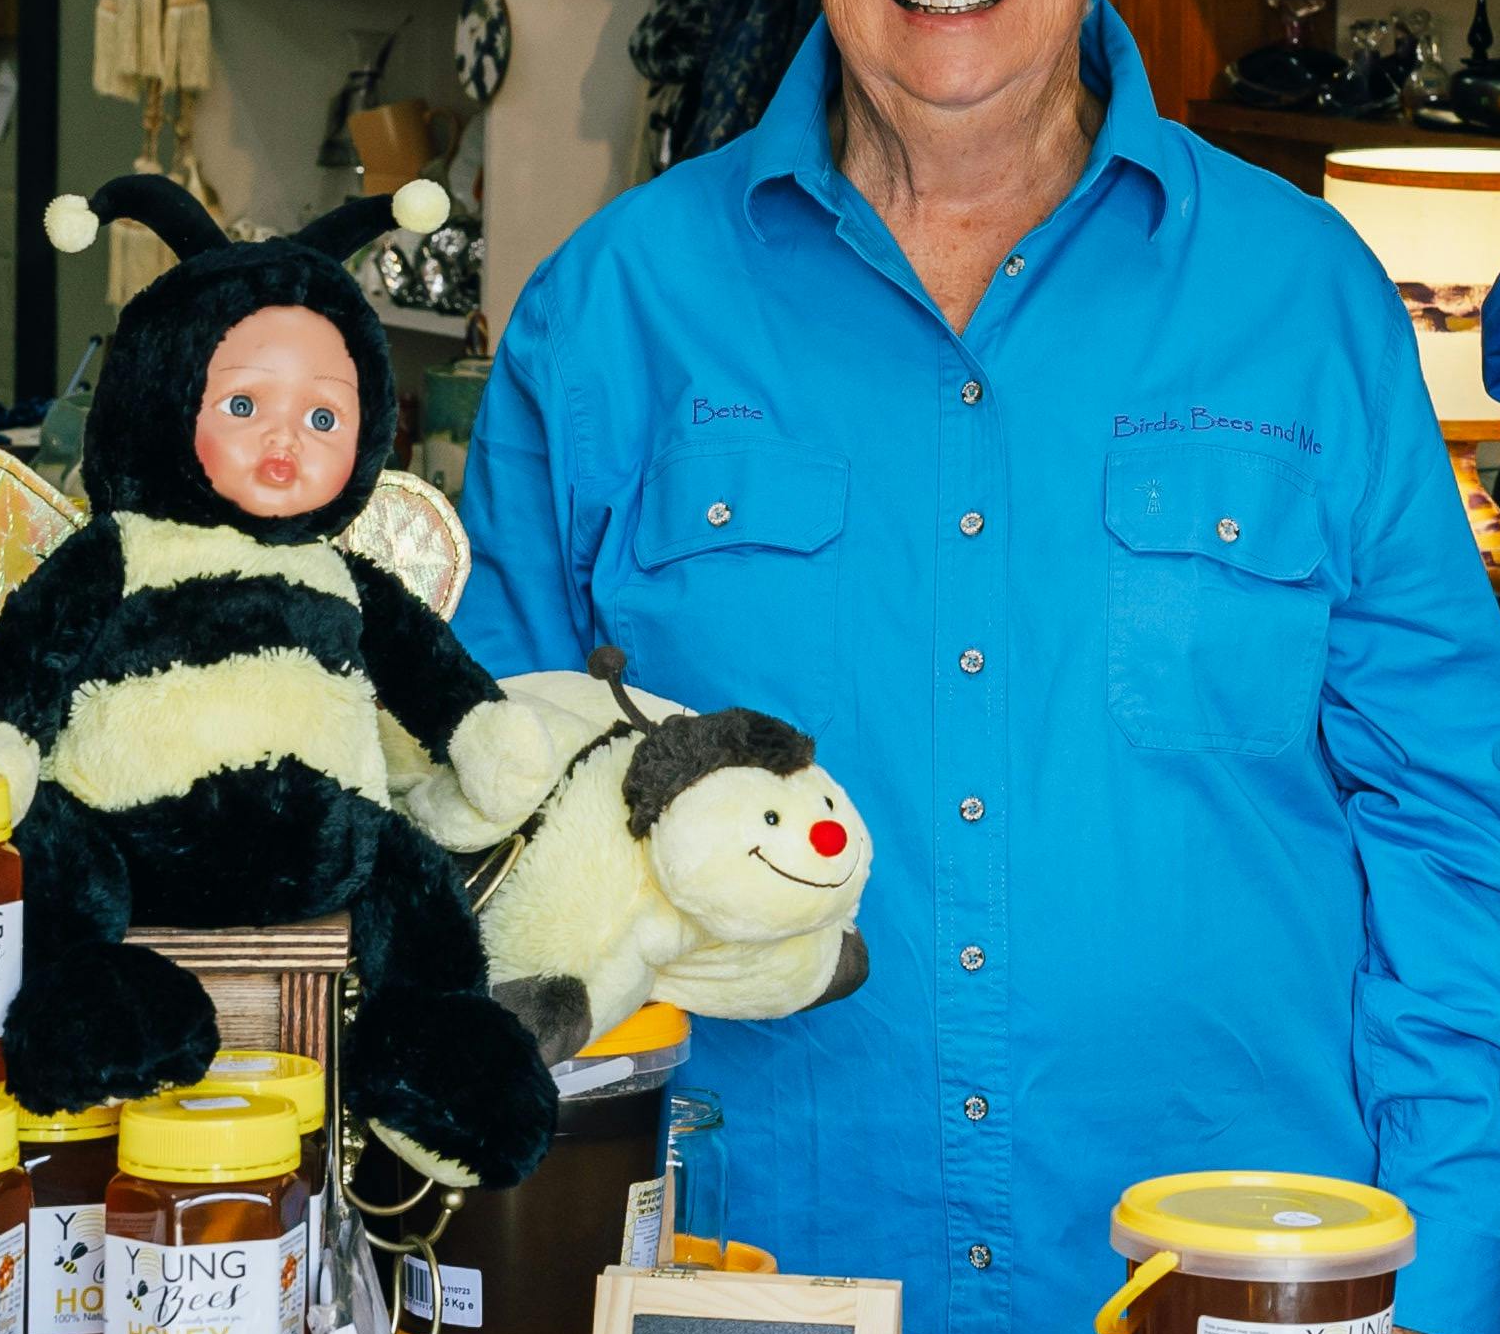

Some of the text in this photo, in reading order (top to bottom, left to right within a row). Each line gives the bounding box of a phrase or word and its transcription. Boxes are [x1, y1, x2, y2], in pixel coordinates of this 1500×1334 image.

[1190, 406, 1255, 434] Bees
[1260, 419, 1297, 444] and
[1298, 428, 1324, 456] Me
[53, 1313, 81, 1324] 100%
[152, 1282, 251, 1328] Bees
[452, 1298, 466, 1310] Kg
